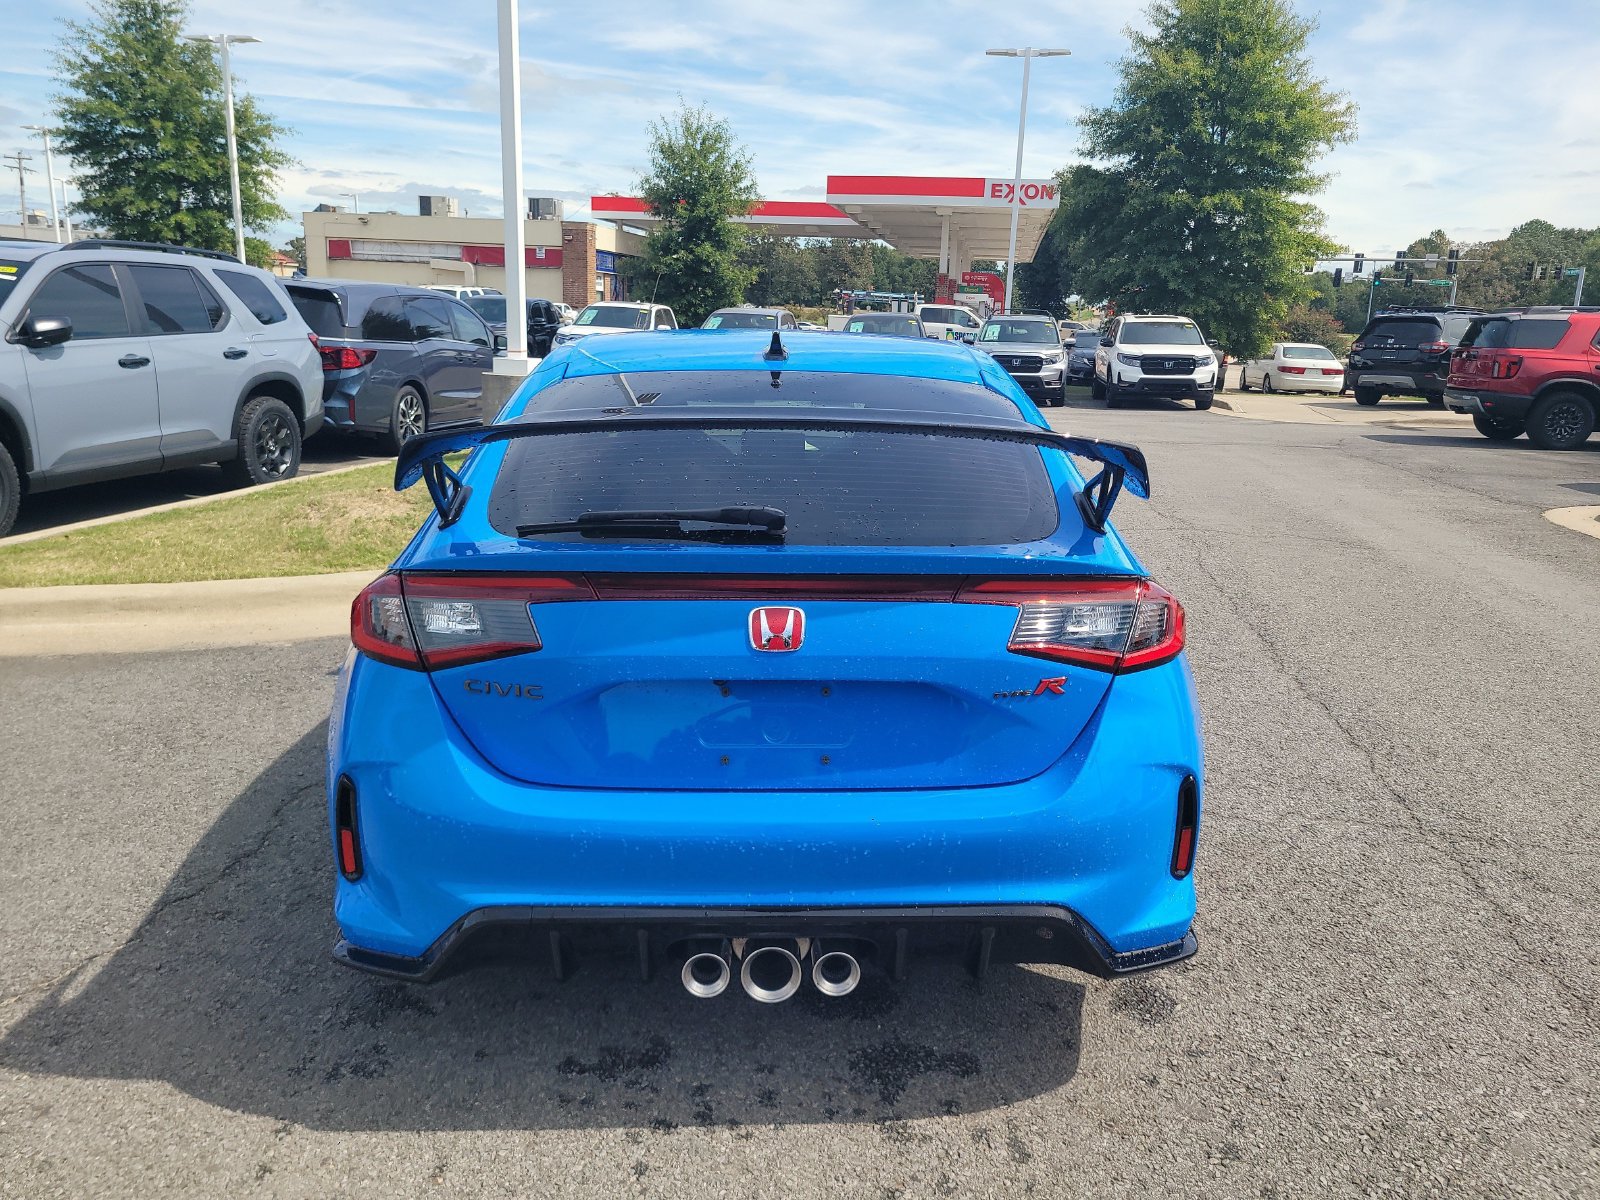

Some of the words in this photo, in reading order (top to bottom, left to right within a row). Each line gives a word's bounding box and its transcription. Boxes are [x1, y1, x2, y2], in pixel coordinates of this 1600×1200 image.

[990, 183, 1055, 206] EXXON
[463, 678, 544, 700] CIVIC
[1033, 675, 1068, 696] R
